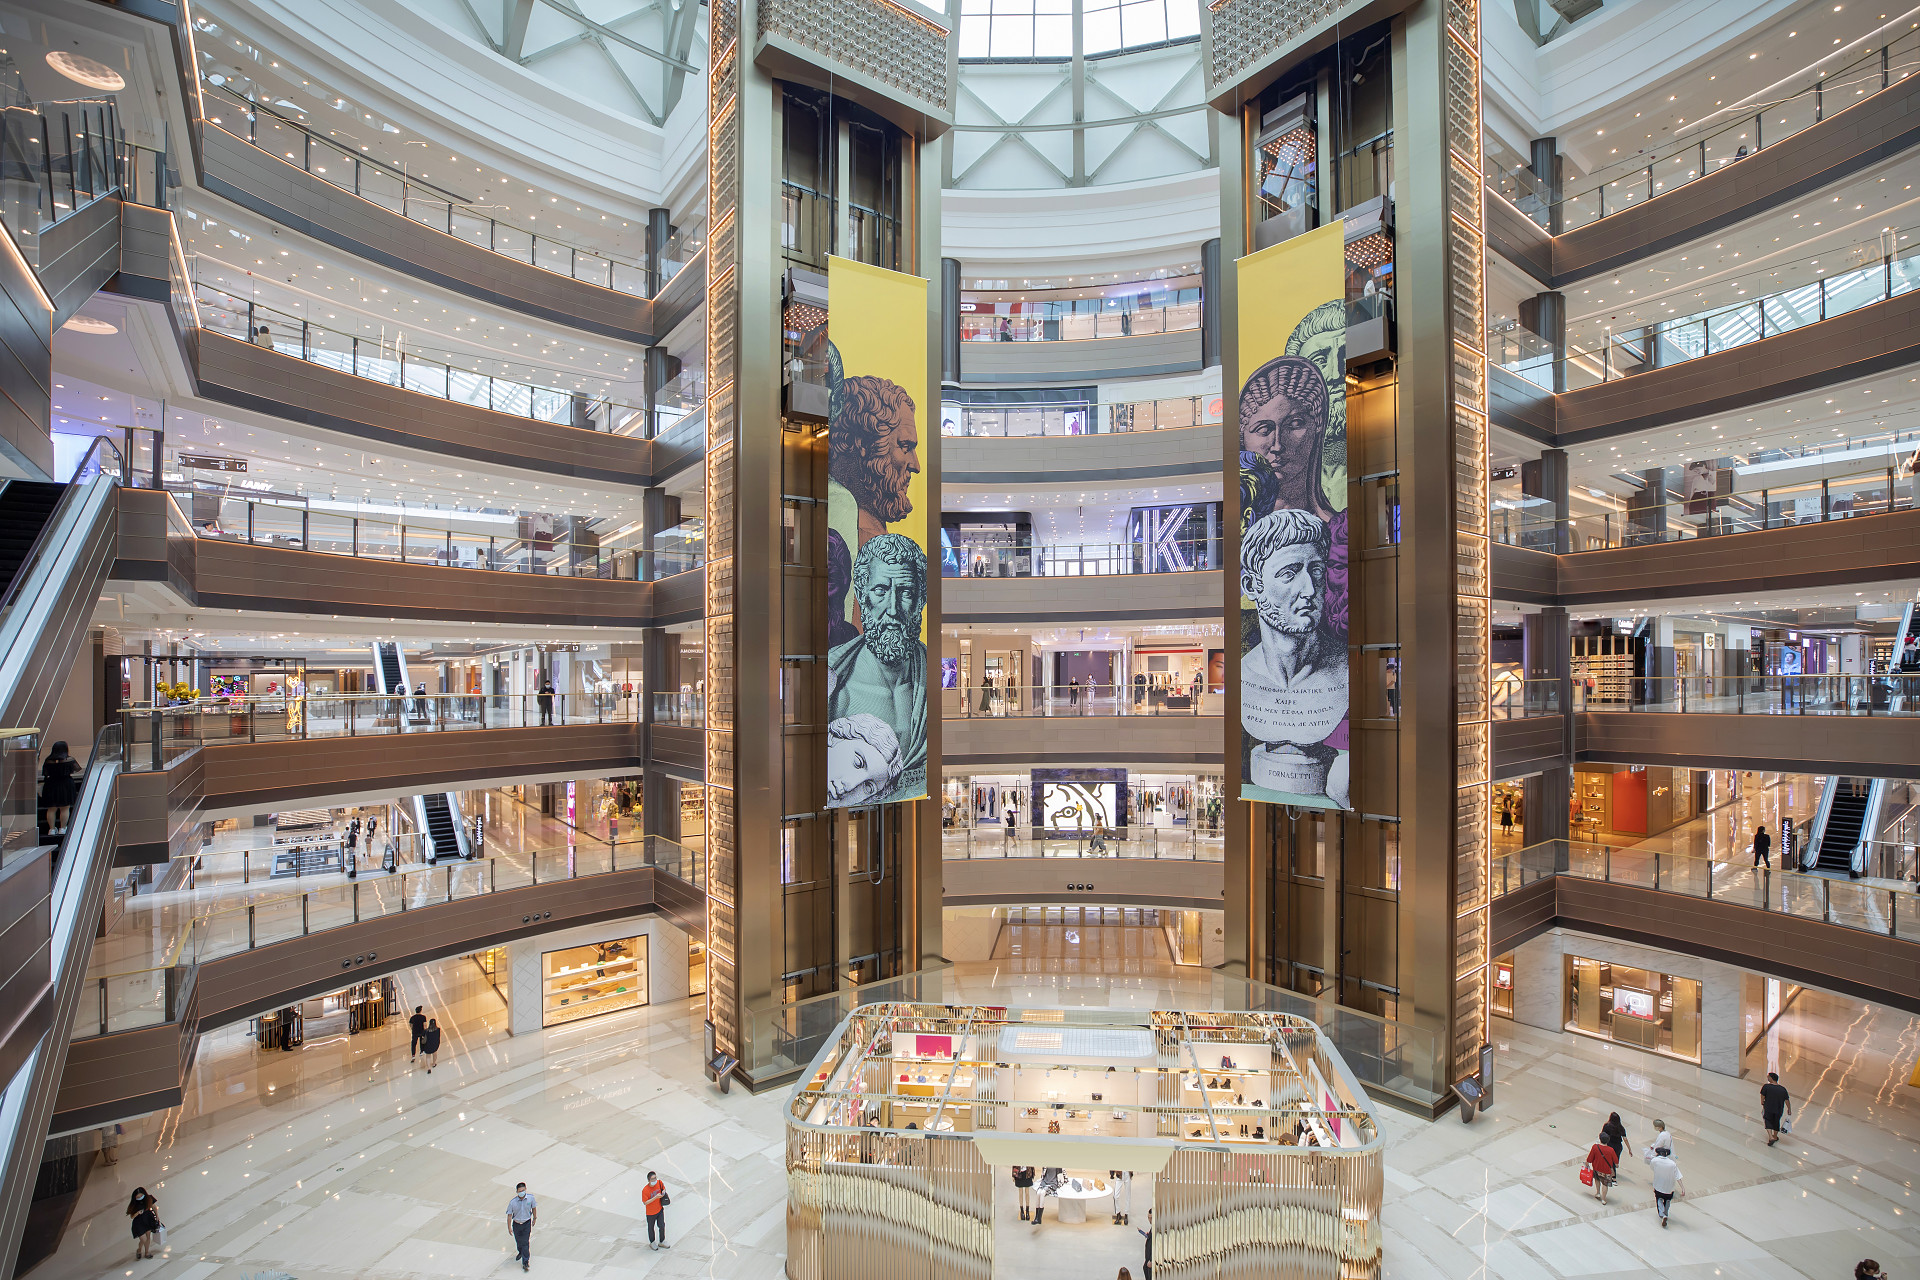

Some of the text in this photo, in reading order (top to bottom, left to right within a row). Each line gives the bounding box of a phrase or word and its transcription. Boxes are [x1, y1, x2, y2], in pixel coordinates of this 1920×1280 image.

[236, 463, 247, 471] L4
[1505, 470, 1514, 478] L4
[240, 480, 273, 491] LAMY
[1142, 507, 1193, 574] K
